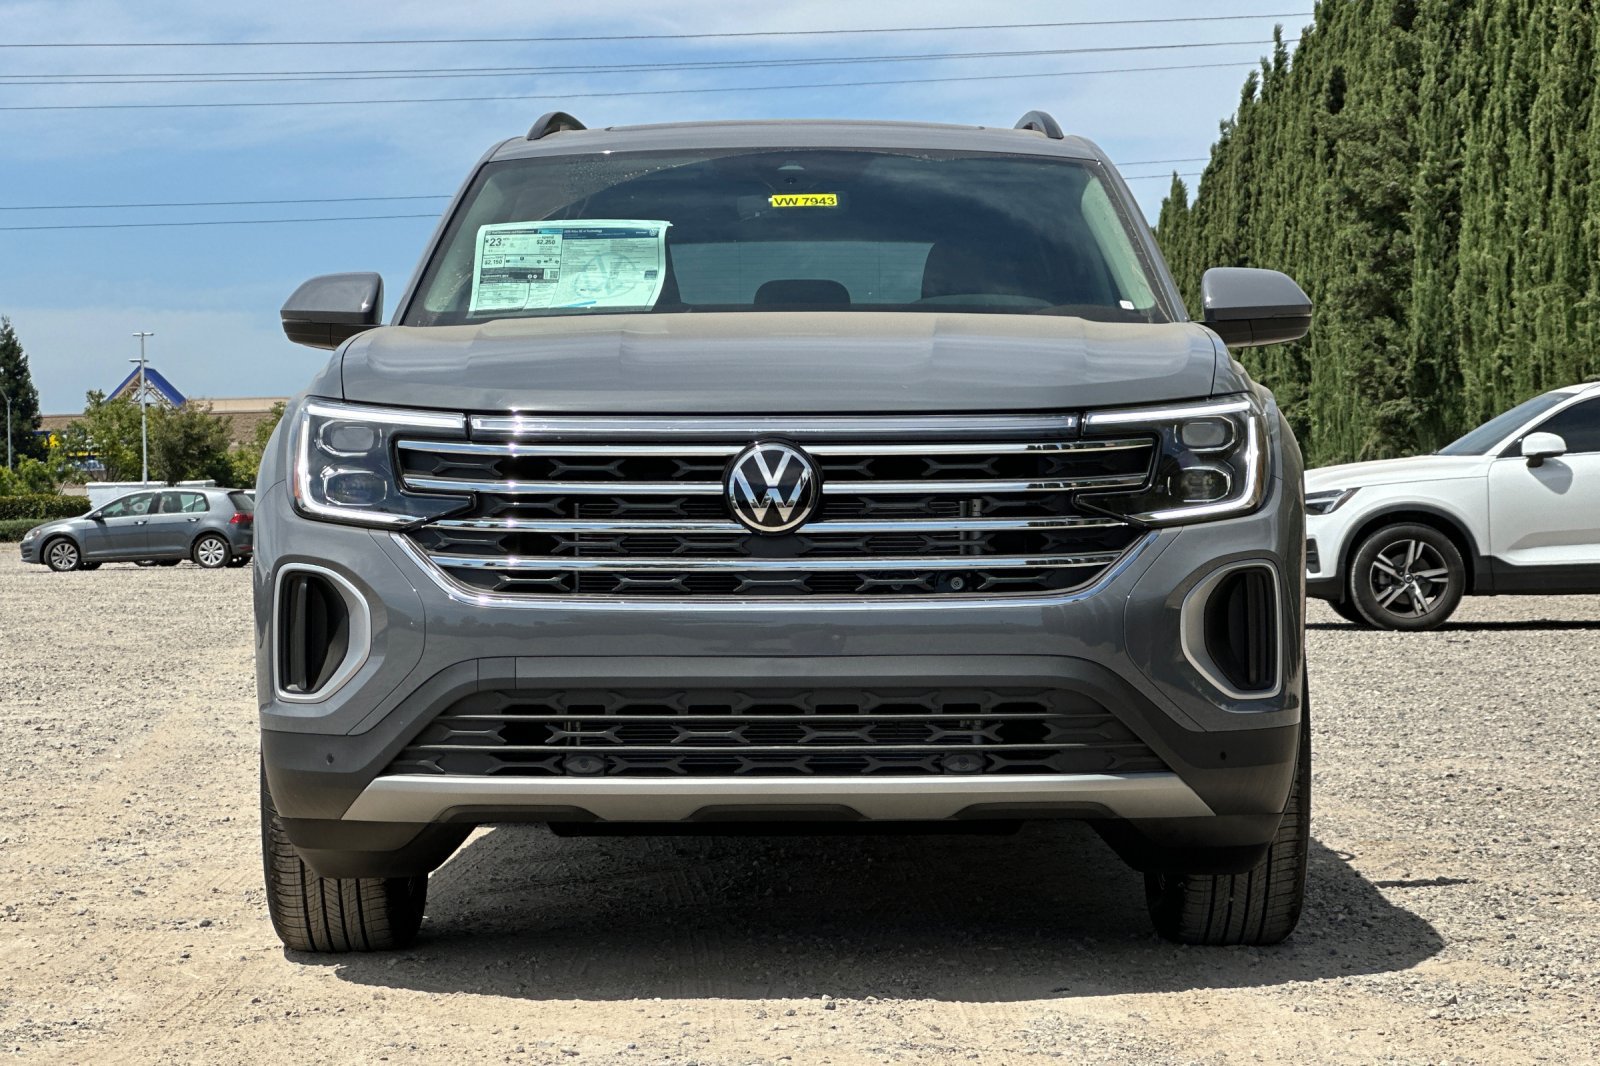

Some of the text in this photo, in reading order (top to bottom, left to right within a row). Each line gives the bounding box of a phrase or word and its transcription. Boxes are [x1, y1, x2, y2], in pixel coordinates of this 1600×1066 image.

[774, 197, 835, 206] VW 7943
[489, 238, 502, 247] 23
